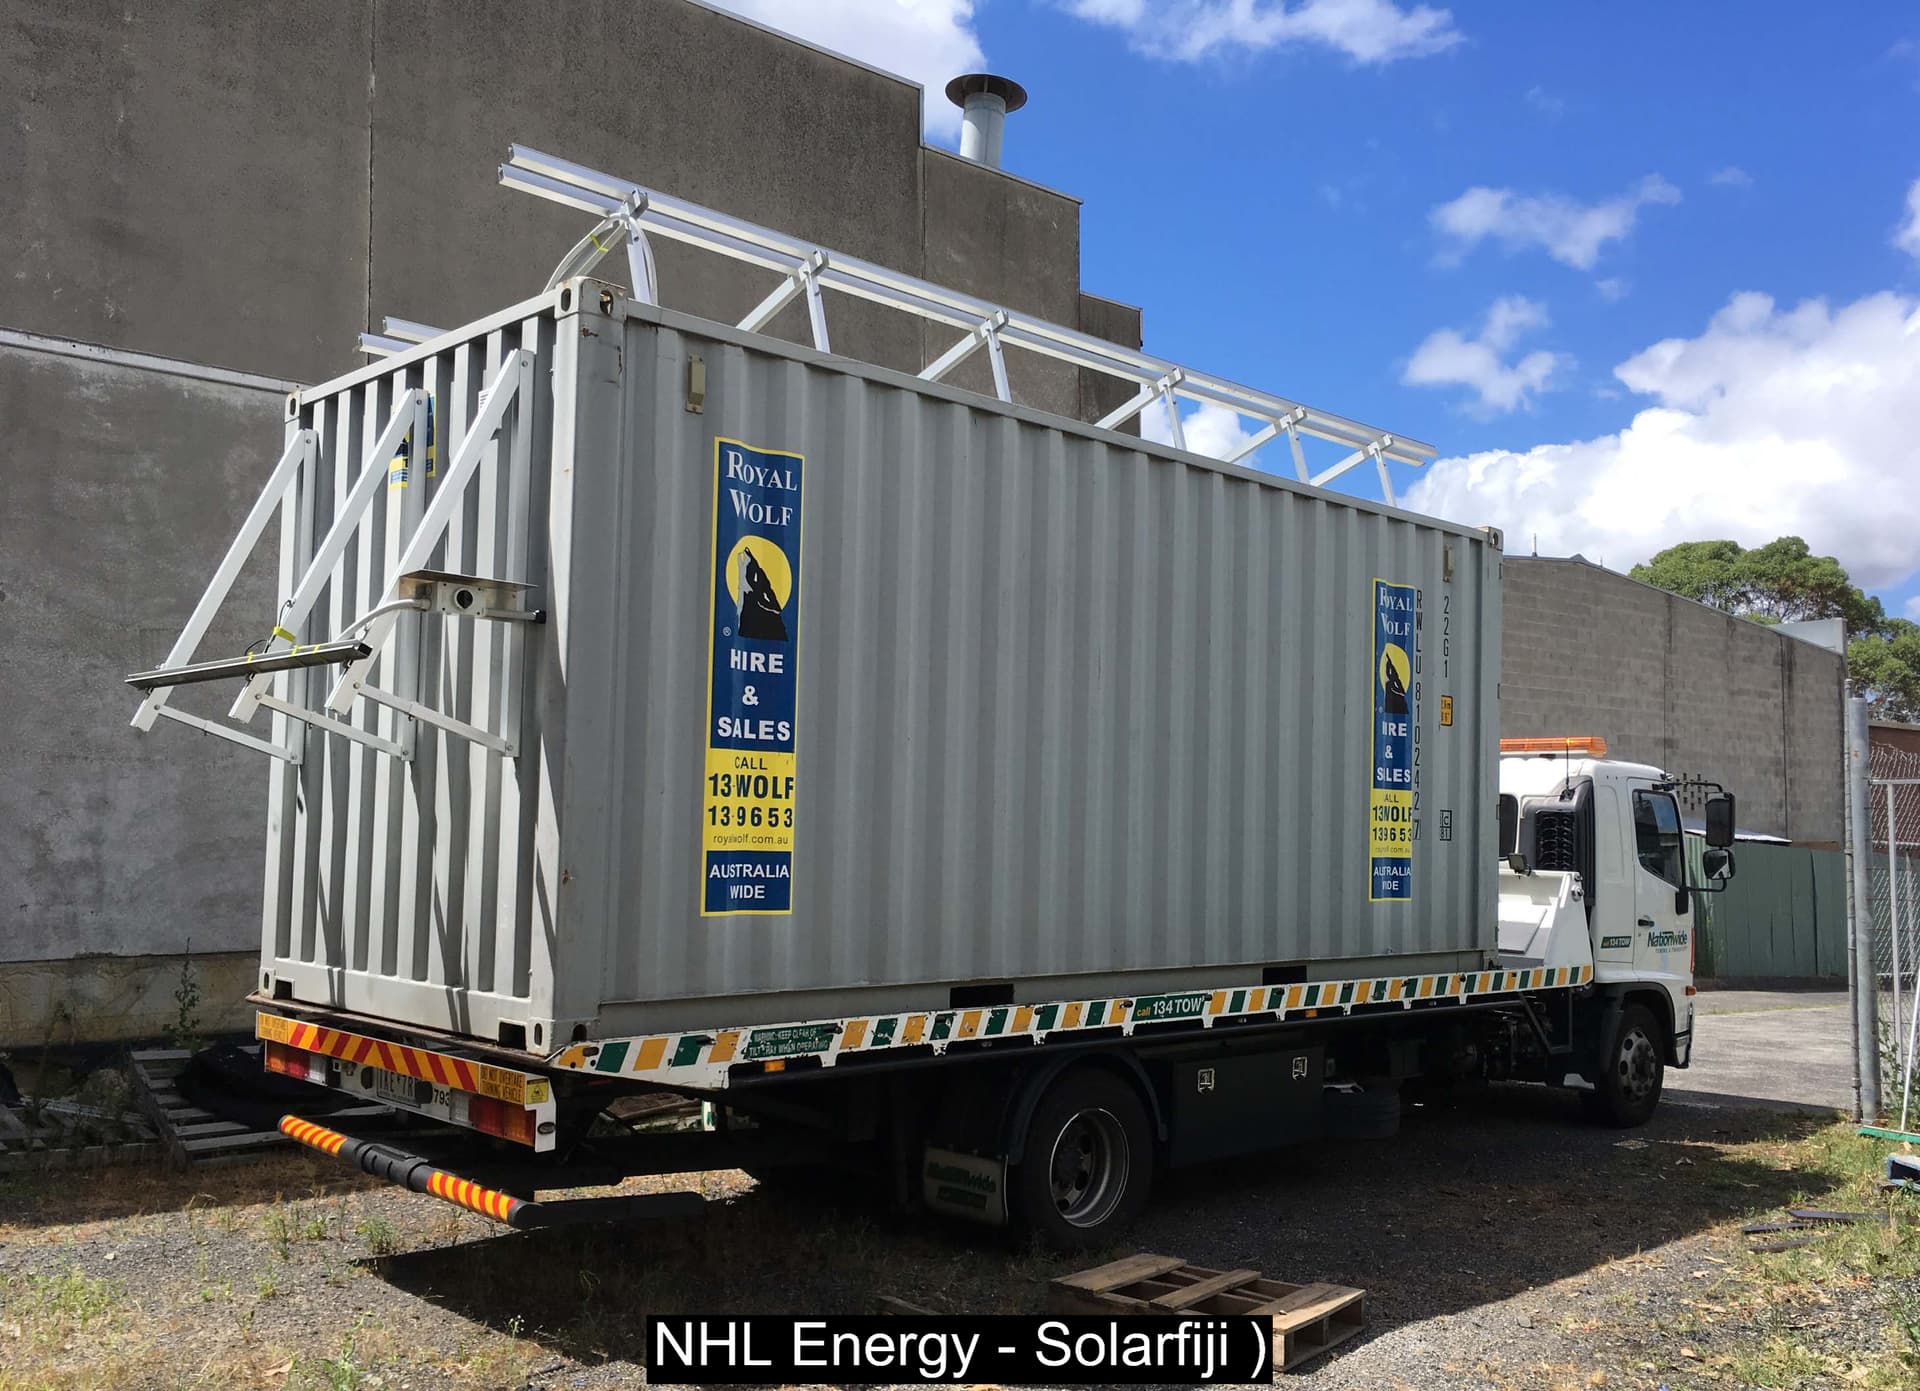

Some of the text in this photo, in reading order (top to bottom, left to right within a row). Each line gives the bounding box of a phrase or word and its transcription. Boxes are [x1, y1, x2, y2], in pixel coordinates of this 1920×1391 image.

[726, 450, 798, 491] ROYAL
[729, 488, 793, 527] WOLF
[730, 648, 784, 674] HIRE
[742, 685, 759, 706] &
[717, 716, 791, 742] SALES
[1385, 745, 1393, 759] &
[734, 756, 768, 770] CALL
[1377, 767, 1411, 783] SLES
[709, 863, 790, 879] AUSTRALIA
[1373, 866, 1411, 876] AUTRALIA
[730, 885, 765, 899] WIDE
